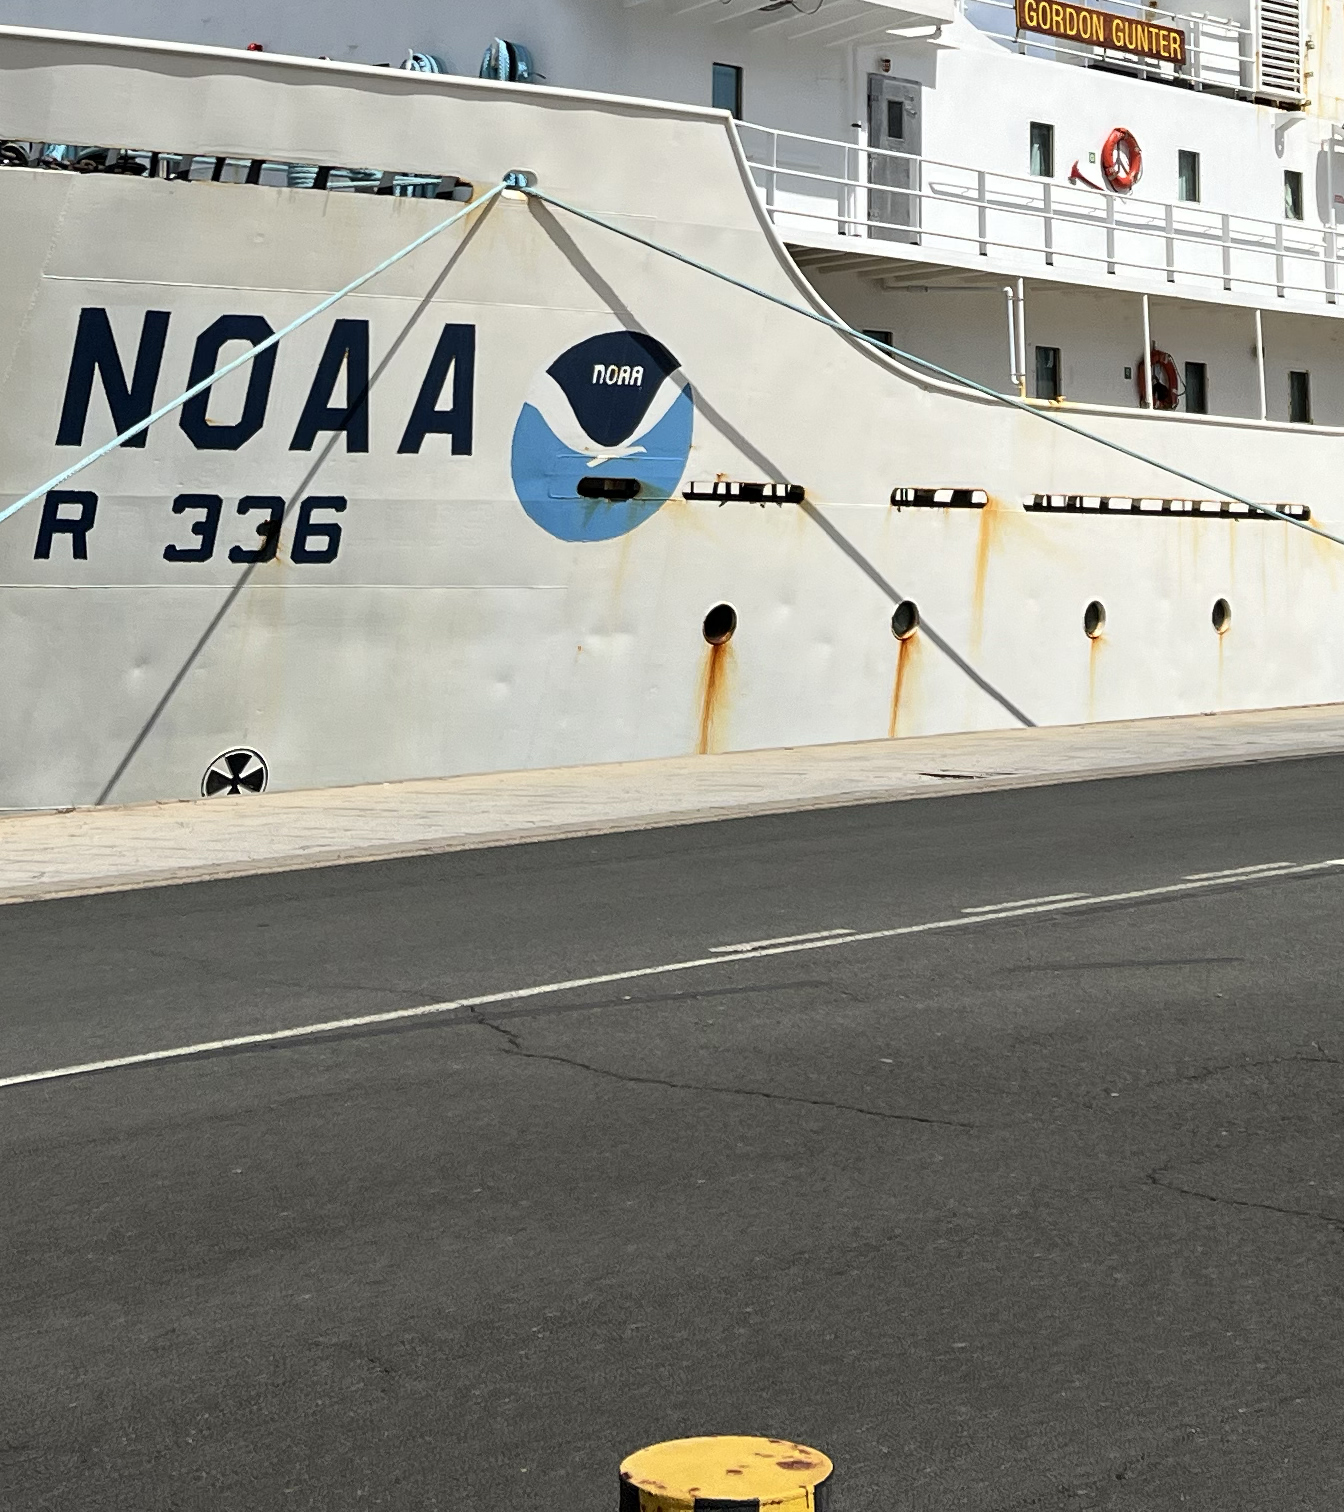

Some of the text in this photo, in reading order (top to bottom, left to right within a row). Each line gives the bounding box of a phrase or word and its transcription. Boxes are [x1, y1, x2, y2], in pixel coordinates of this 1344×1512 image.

[1112, 19, 1182, 60] GUNTER
[55, 307, 477, 456] NOAA
[34, 490, 348, 565] R 336
